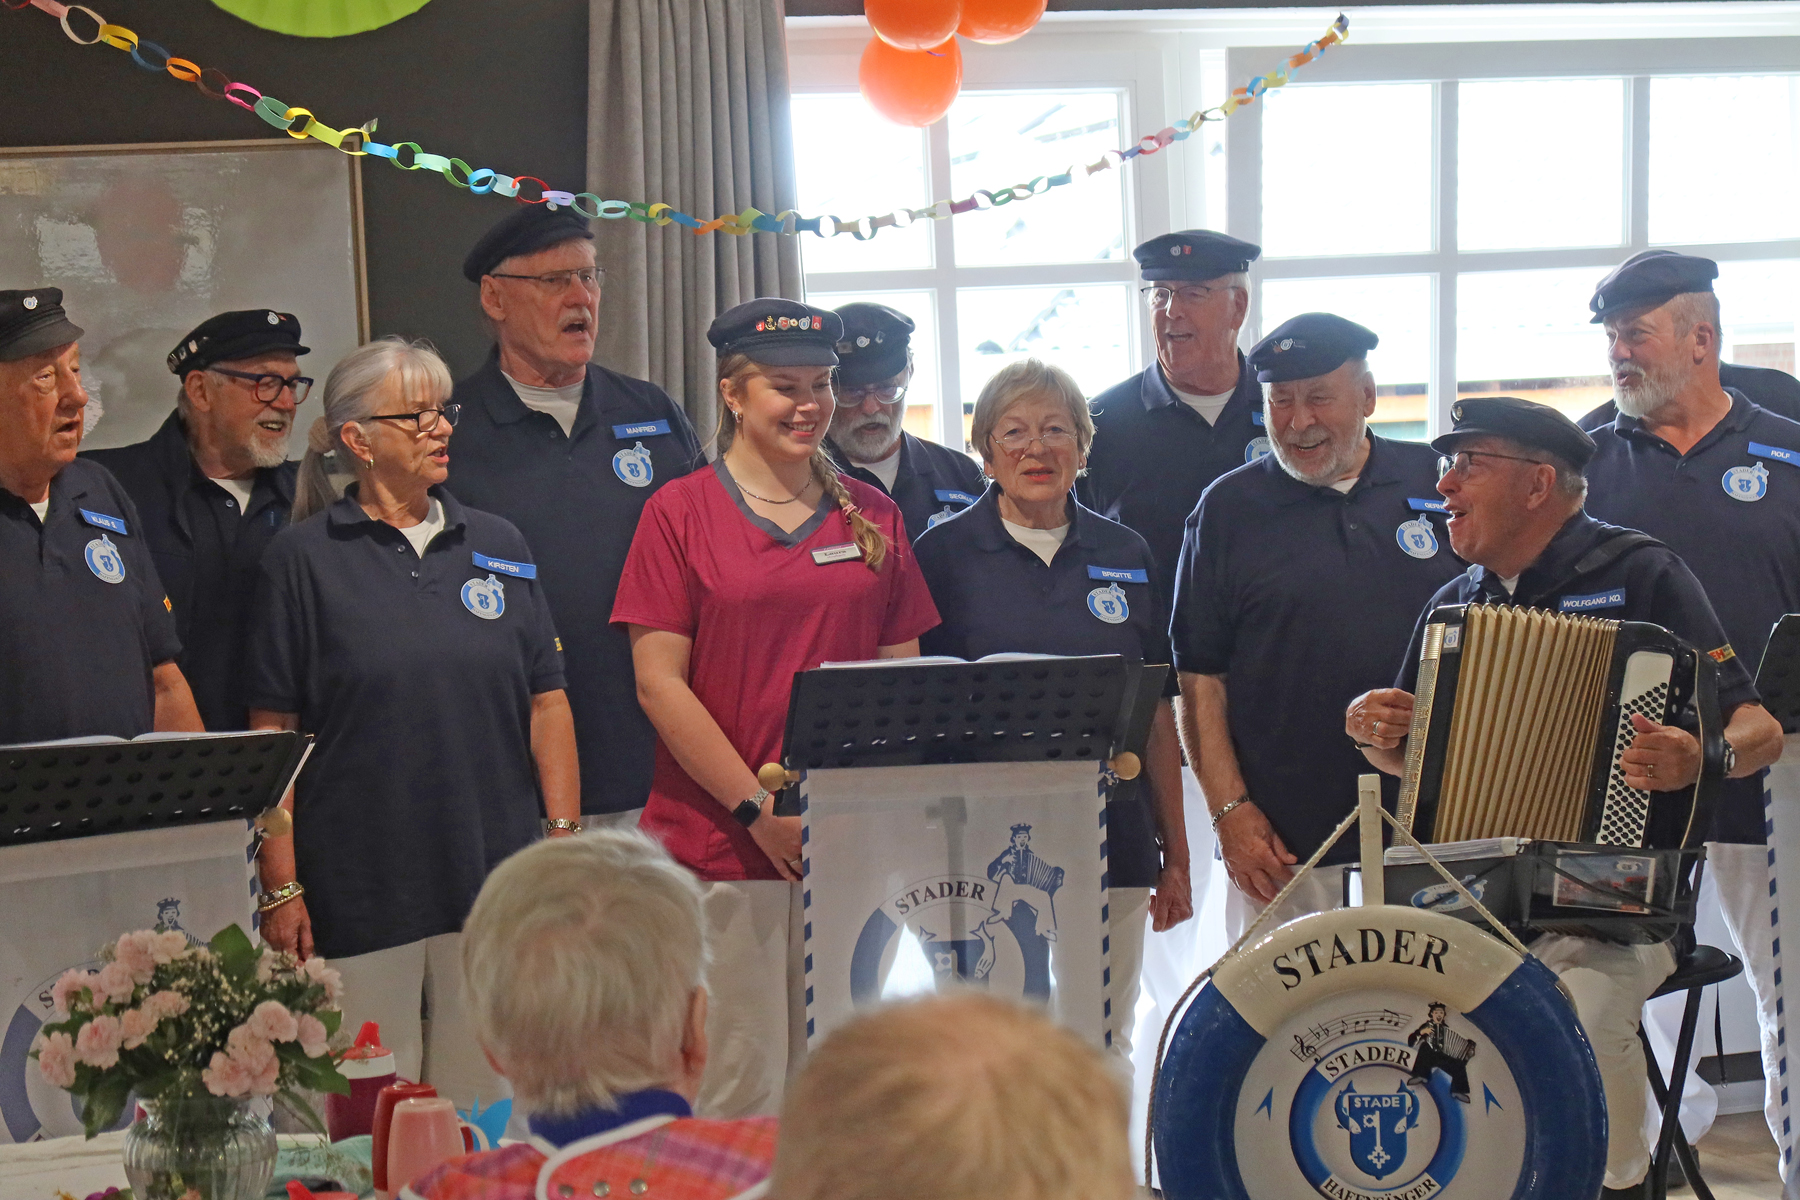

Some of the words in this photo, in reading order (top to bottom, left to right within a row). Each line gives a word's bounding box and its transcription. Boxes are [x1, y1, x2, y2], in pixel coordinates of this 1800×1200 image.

[625, 425, 657, 434] MANFRED
[1770, 449, 1791, 459] ROLF
[487, 560, 520, 573] KIRSTEN
[1101, 570, 1133, 580] BRIGITTE
[1563, 596, 1607, 608] WOLFGANG
[1609, 594, 1622, 603] KO.
[895, 880, 985, 915] STADER
[1273, 928, 1449, 992] STADER
[1325, 1046, 1411, 1078] STADER
[1354, 1096, 1401, 1109] STADE
[1323, 1178, 1437, 1200] HAFÄNGER
